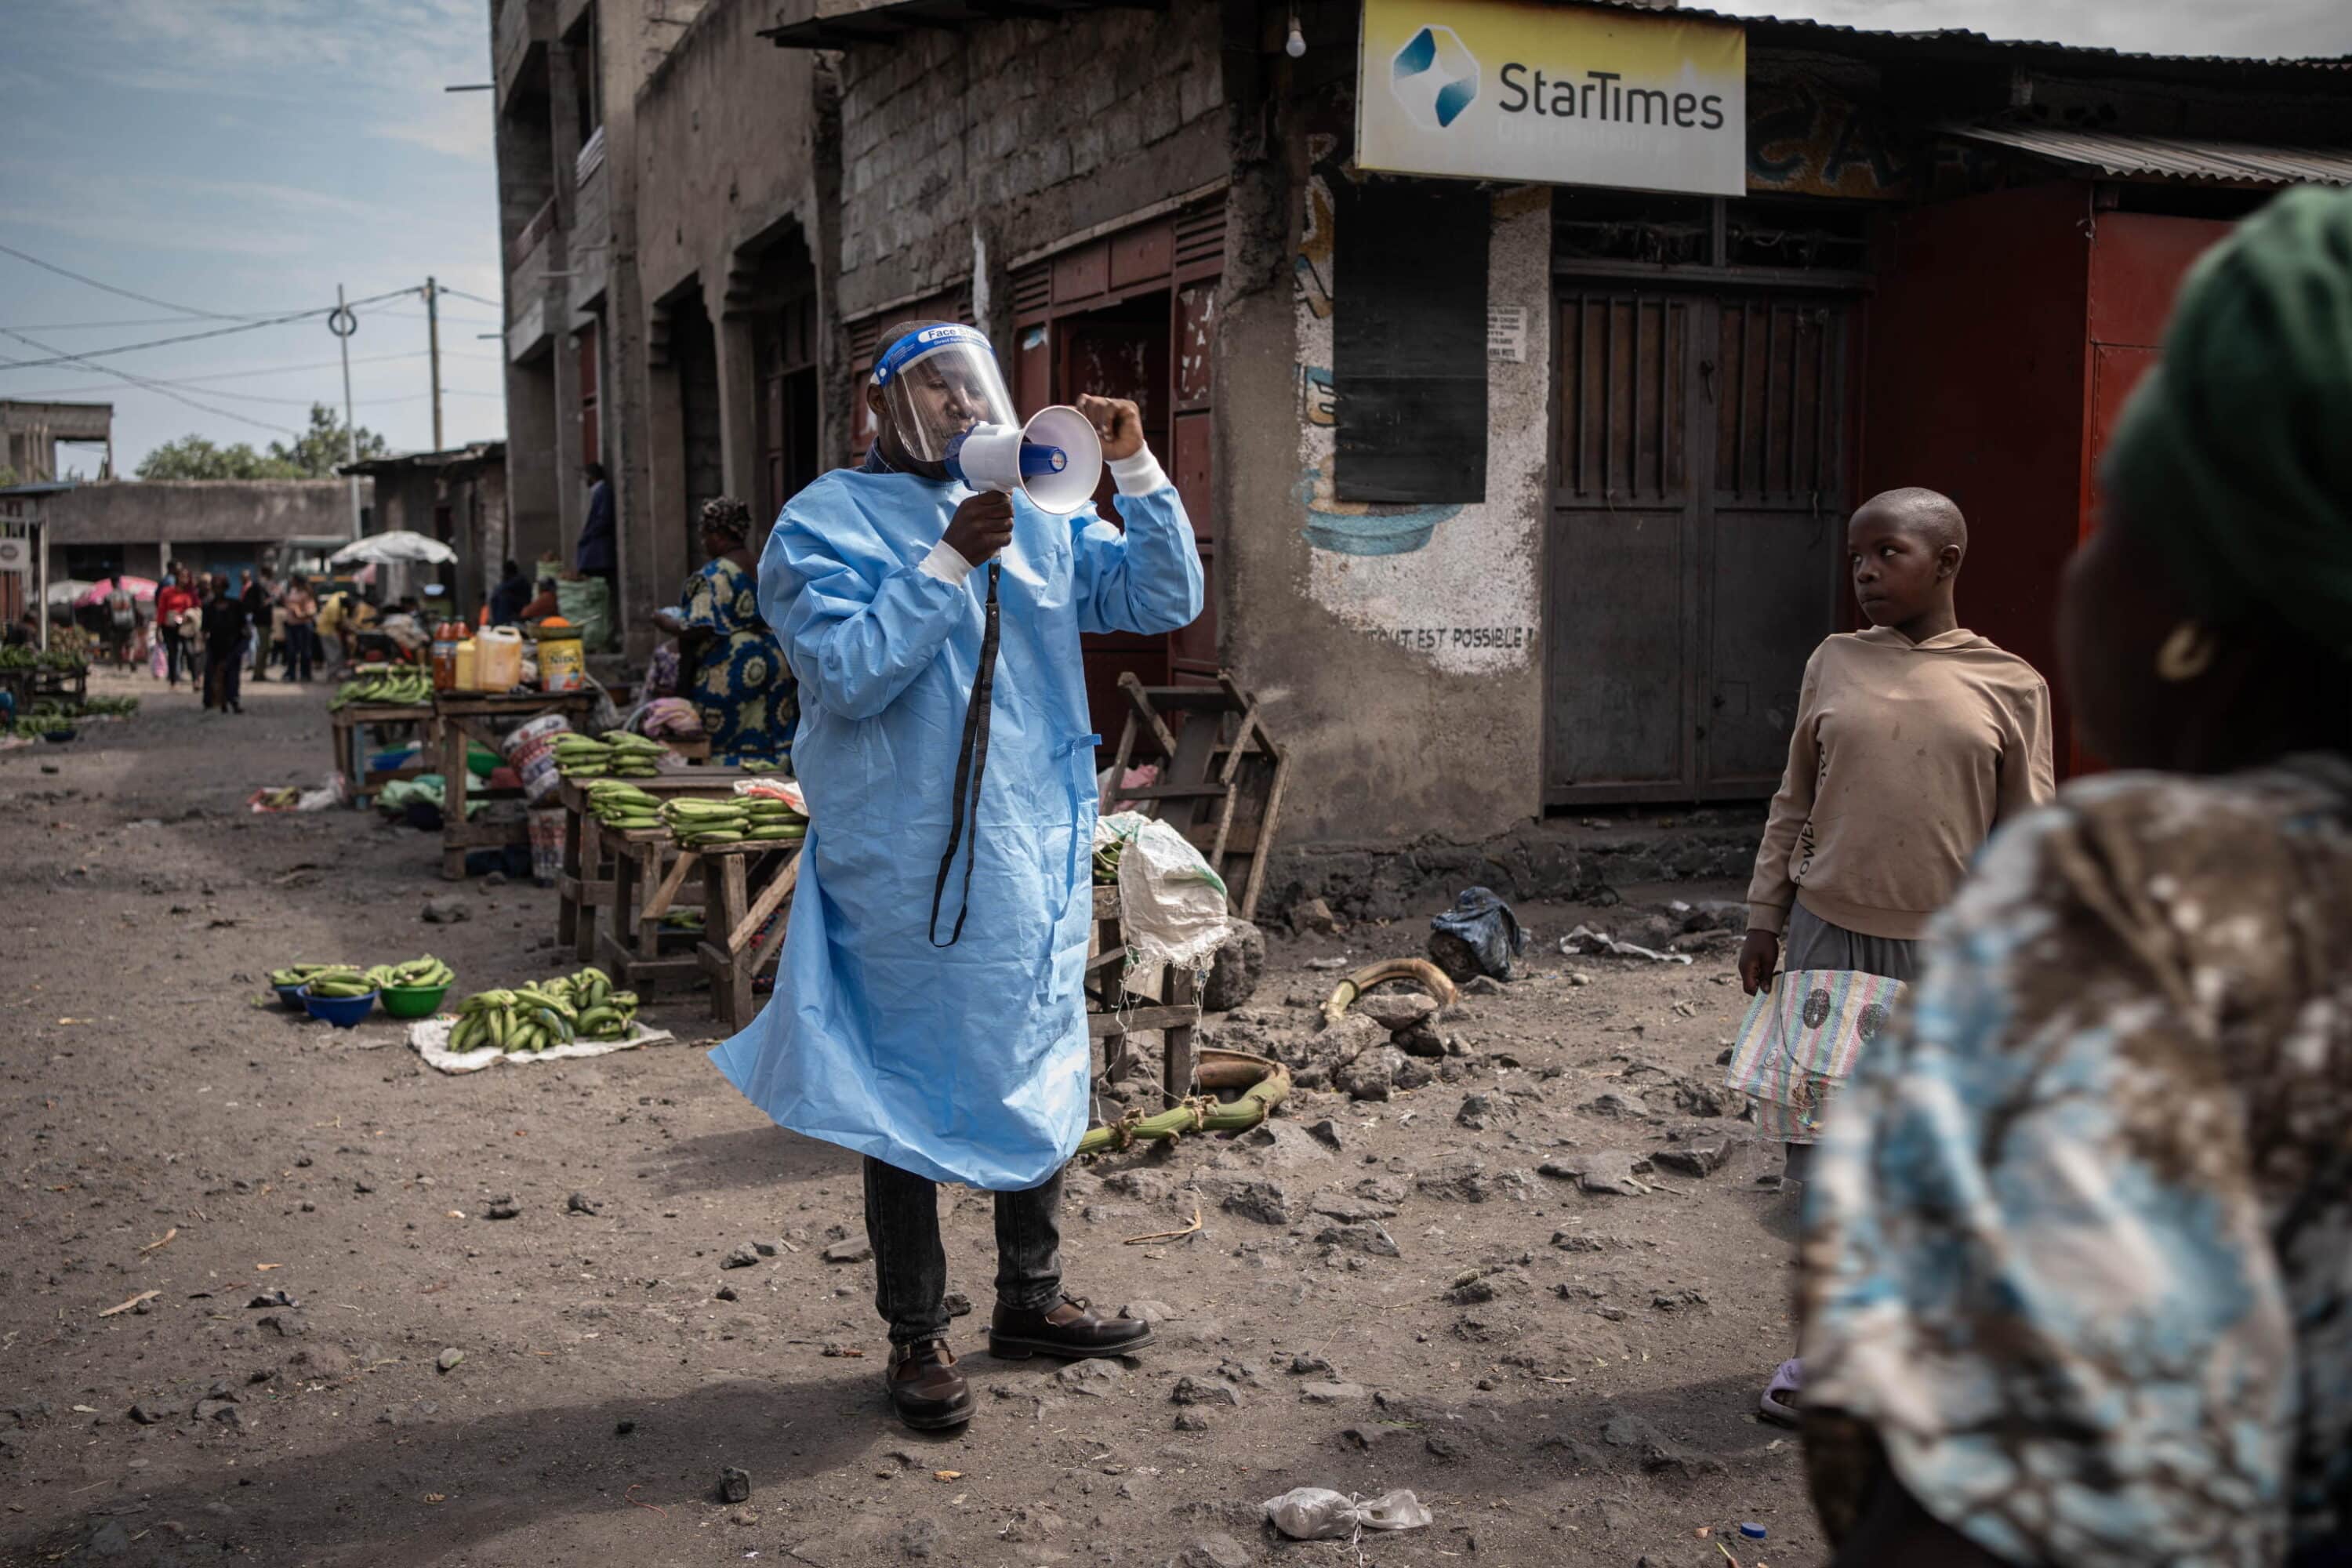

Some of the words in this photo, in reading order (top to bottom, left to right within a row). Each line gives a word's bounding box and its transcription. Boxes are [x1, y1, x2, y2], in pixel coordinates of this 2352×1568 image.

[1498, 62, 1724, 130] StarTimes
[927, 328, 956, 339] Face
[1417, 627, 1446, 649] EST
[1452, 626, 1523, 649] POSSIBLE
[1794, 819, 1817, 889] POWE
